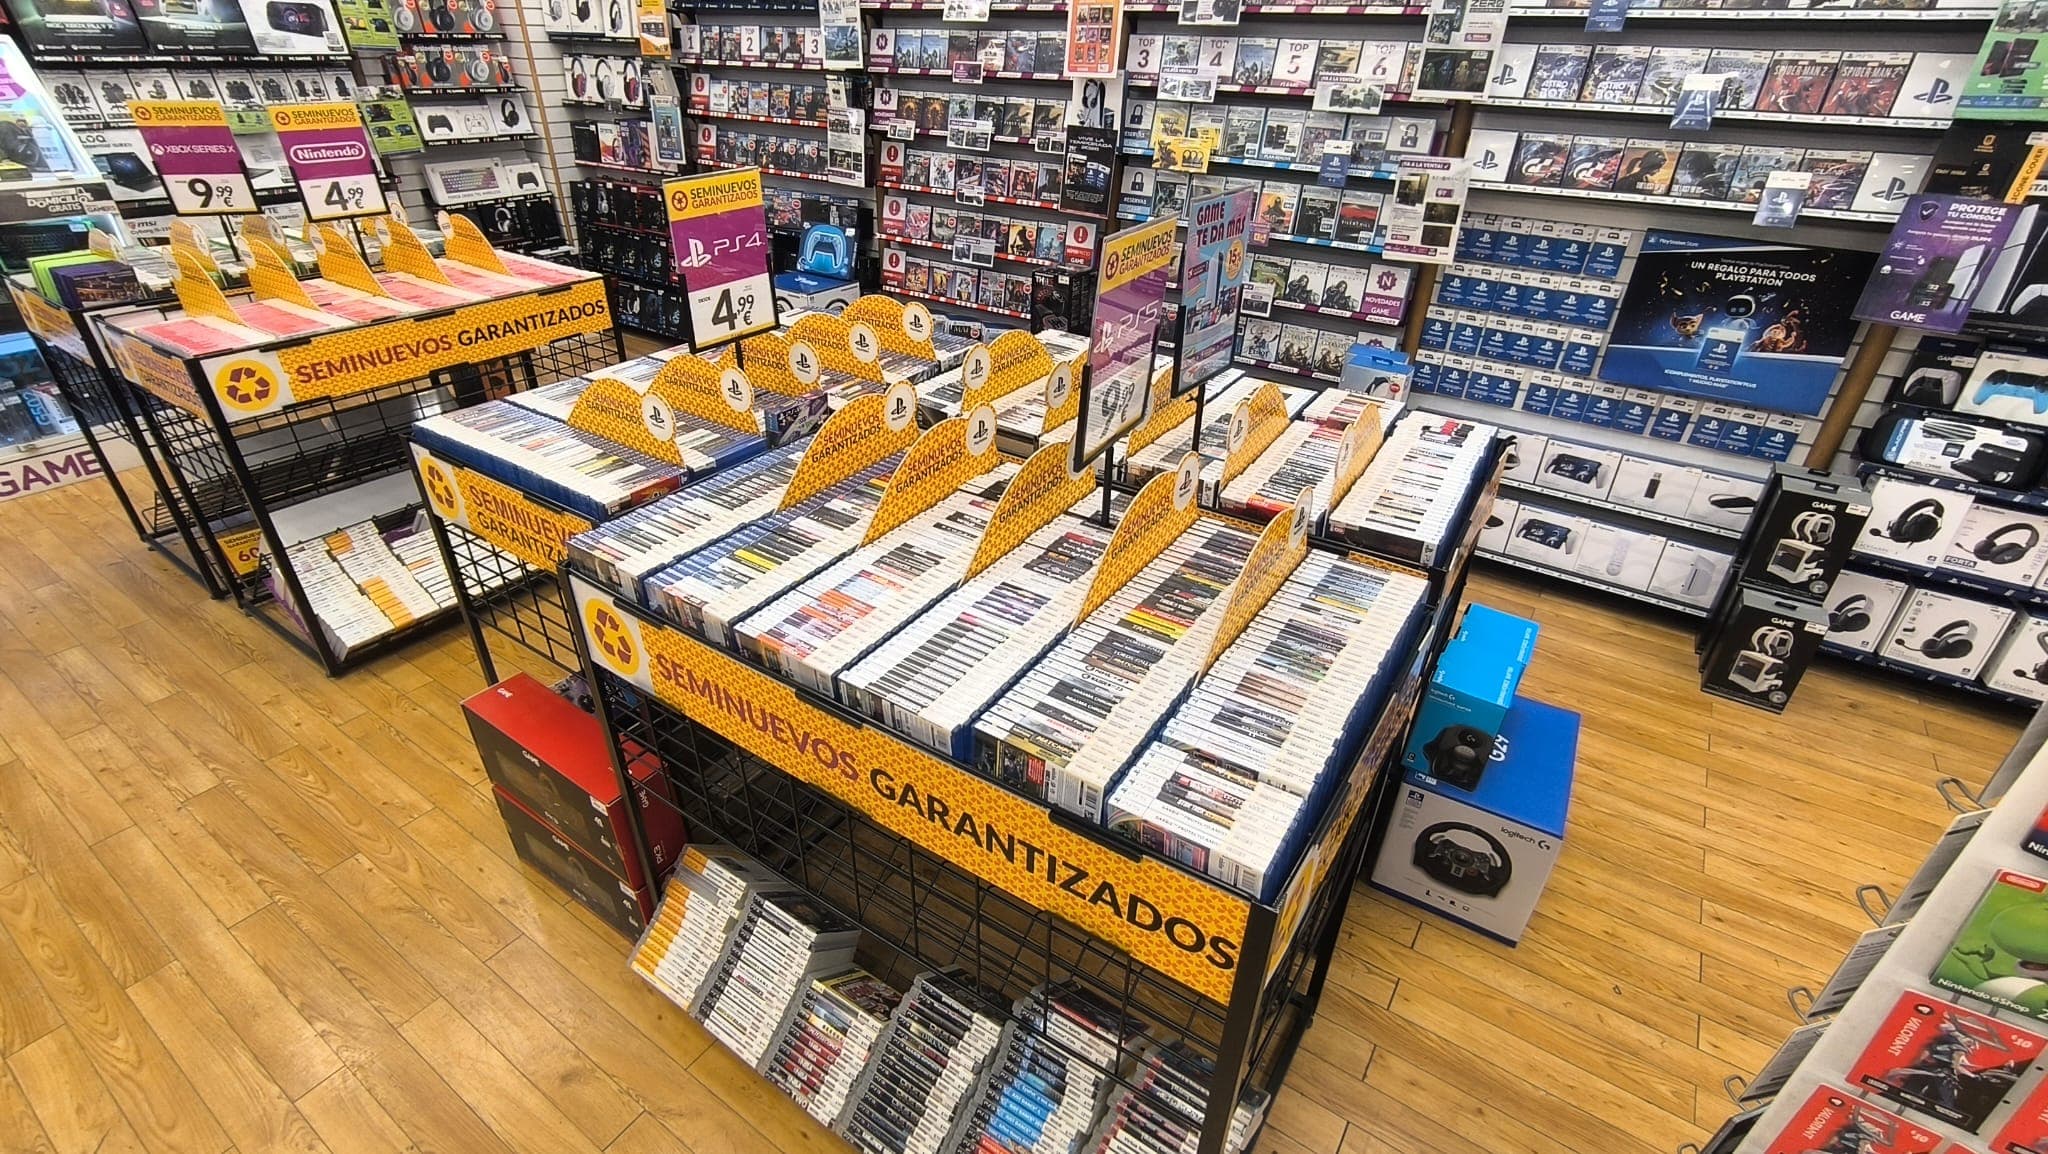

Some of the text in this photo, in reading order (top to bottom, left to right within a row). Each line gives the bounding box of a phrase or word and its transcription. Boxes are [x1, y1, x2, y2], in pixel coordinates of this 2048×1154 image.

[688, 36, 694, 49] 1
[746, 37, 753, 51] 2
[811, 39, 819, 54] 3
[1138, 38, 1156, 47] TOP
[1289, 43, 1309, 52] TOP
[1138, 50, 1149, 68] 3
[1209, 52, 1223, 67] 4
[1287, 55, 1302, 73] 5
[1372, 57, 1387, 76] 6
[1774, 64, 1829, 77] SPIDER-MAN 2
[1841, 66, 1889, 78] SPIDER-MAN
[1541, 80, 1569, 89] ASTRO
[1597, 81, 1626, 90] ASTRO
[153, 106, 220, 115] SEMINUEVOS
[155, 113, 223, 122] GARANTIZADOS
[292, 108, 355, 118] SEMINUEVOS
[294, 116, 357, 125] GARANTIZADOS
[78, 134, 107, 144] LOQ
[164, 143, 236, 154] XBOX SERIES X
[298, 146, 361, 161] Nintendo
[2027, 147, 2045, 176] COVER
[690, 178, 757, 199] SEMINUEVOS
[691, 189, 758, 210] GARANTIZADOS
[1197, 201, 1226, 226] GAME
[1949, 203, 2008, 216] PROTEGE
[1960, 212, 2002, 222] CONSOLA
[1196, 215, 1246, 248] TE DA MÁS
[713, 232, 763, 256] PS4
[1121, 229, 1173, 263] SEMINUEVOS
[1070, 257, 1085, 265] GAME
[1119, 244, 1171, 275] GARANTIZADOS
[1691, 261, 1706, 270] UN
[1707, 263, 1749, 275] REGALO
[1749, 267, 1778, 278] PARA
[1778, 270, 1817, 283] TODOS
[1715, 272, 1784, 288] PLAYSTATION
[1365, 296, 1401, 307] NOVEDADES
[1370, 306, 1391, 316] GAME
[743, 311, 753, 326] €
[847, 313, 901, 332] GARANTIZADOS
[854, 306, 899, 323] SEMINUEVOS
[1117, 300, 1159, 338] PS5
[1890, 309, 1927, 323] GAME
[296, 299, 606, 384] SEMINUEVOS GARANTIZADOS
[792, 331, 849, 351] GARANTIZADOS
[799, 324, 850, 342] SEMINUEVOS
[664, 374, 720, 399] GARANTIZADOS
[671, 365, 718, 389] SEMINUEVOS
[20, 391, 51, 427] G502
[591, 389, 641, 414] SEMINUEVOS
[585, 398, 642, 425] GARANTIZADOS
[823, 413, 880, 443] SEMINUEVOS
[811, 423, 883, 463] GARANTIZADOS
[907, 436, 962, 473] SEMINUEVOS
[0, 450, 104, 497] GAME
[895, 449, 964, 494] GARANTIZADOS
[1010, 462, 1064, 502] SEMINUEVOS
[998, 474, 1064, 524] GARANTIZADOS
[1811, 500, 1837, 513] GAME
[1122, 494, 1171, 536] SEMINUEVOS
[1110, 508, 1171, 560] GARANTIZADOS
[1944, 556, 1977, 568] FORTA
[1770, 617, 1796, 629] GAME
[654, 652, 1238, 971] SEMINUEVOS GARANTIZADOS
[1500, 826, 1536, 845] logitech
[1937, 977, 1991, 1002] Nintendo
[1991, 996, 2031, 1014] eShop
[1886, 1017, 1922, 1057] VALORANT
[1802, 1107, 1834, 1140] VALORANT
